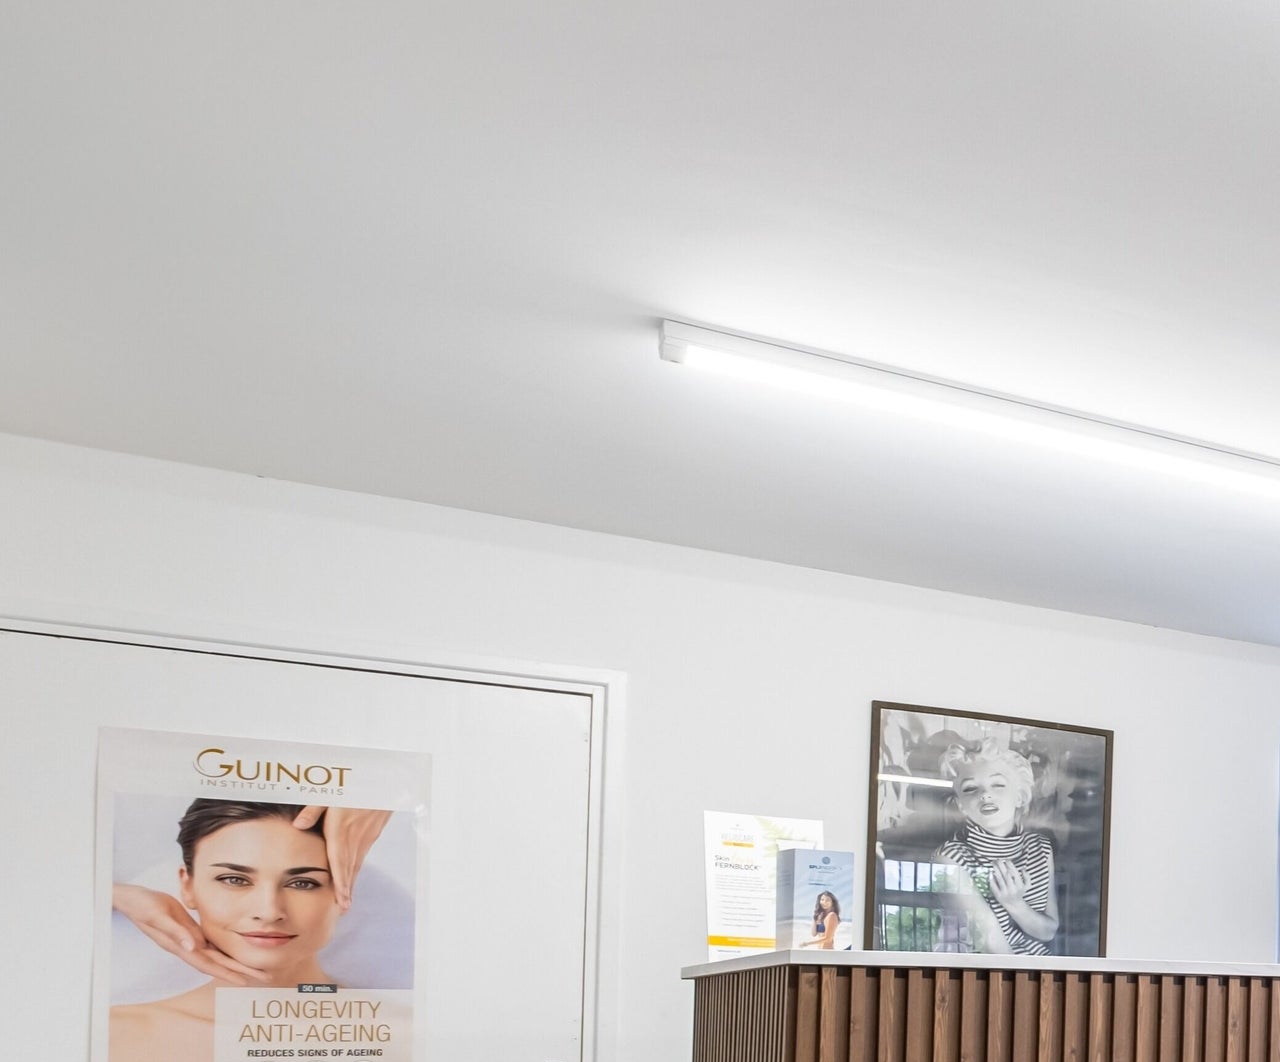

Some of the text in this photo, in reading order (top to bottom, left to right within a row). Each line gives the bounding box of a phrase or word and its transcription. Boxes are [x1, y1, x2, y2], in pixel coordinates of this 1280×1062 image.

[193, 748, 353, 787] GUINOT
[200, 779, 344, 796] INSTITUT PARIS
[252, 999, 382, 1019] LONGEVITY
[238, 1024, 391, 1043] ANTI-AGEING
[247, 1049, 383, 1057] REDUCES SIGNS OF AGEING
